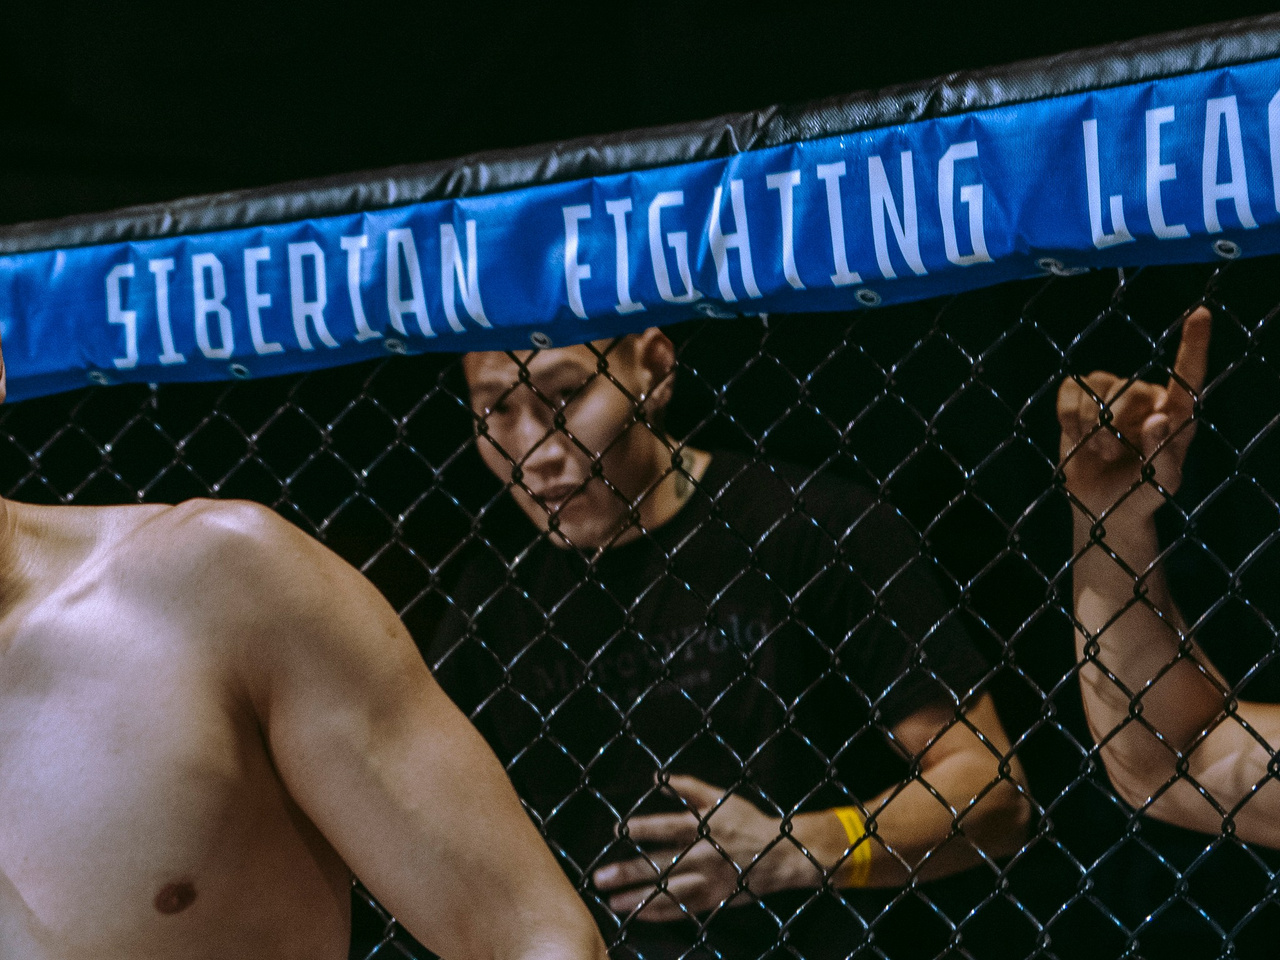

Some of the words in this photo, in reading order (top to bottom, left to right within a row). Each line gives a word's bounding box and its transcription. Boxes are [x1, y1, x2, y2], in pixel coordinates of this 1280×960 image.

[106, 219, 493, 369] SIBERIAN
[562, 140, 995, 320] FIGHTING
[1082, 88, 1280, 250] LEA
